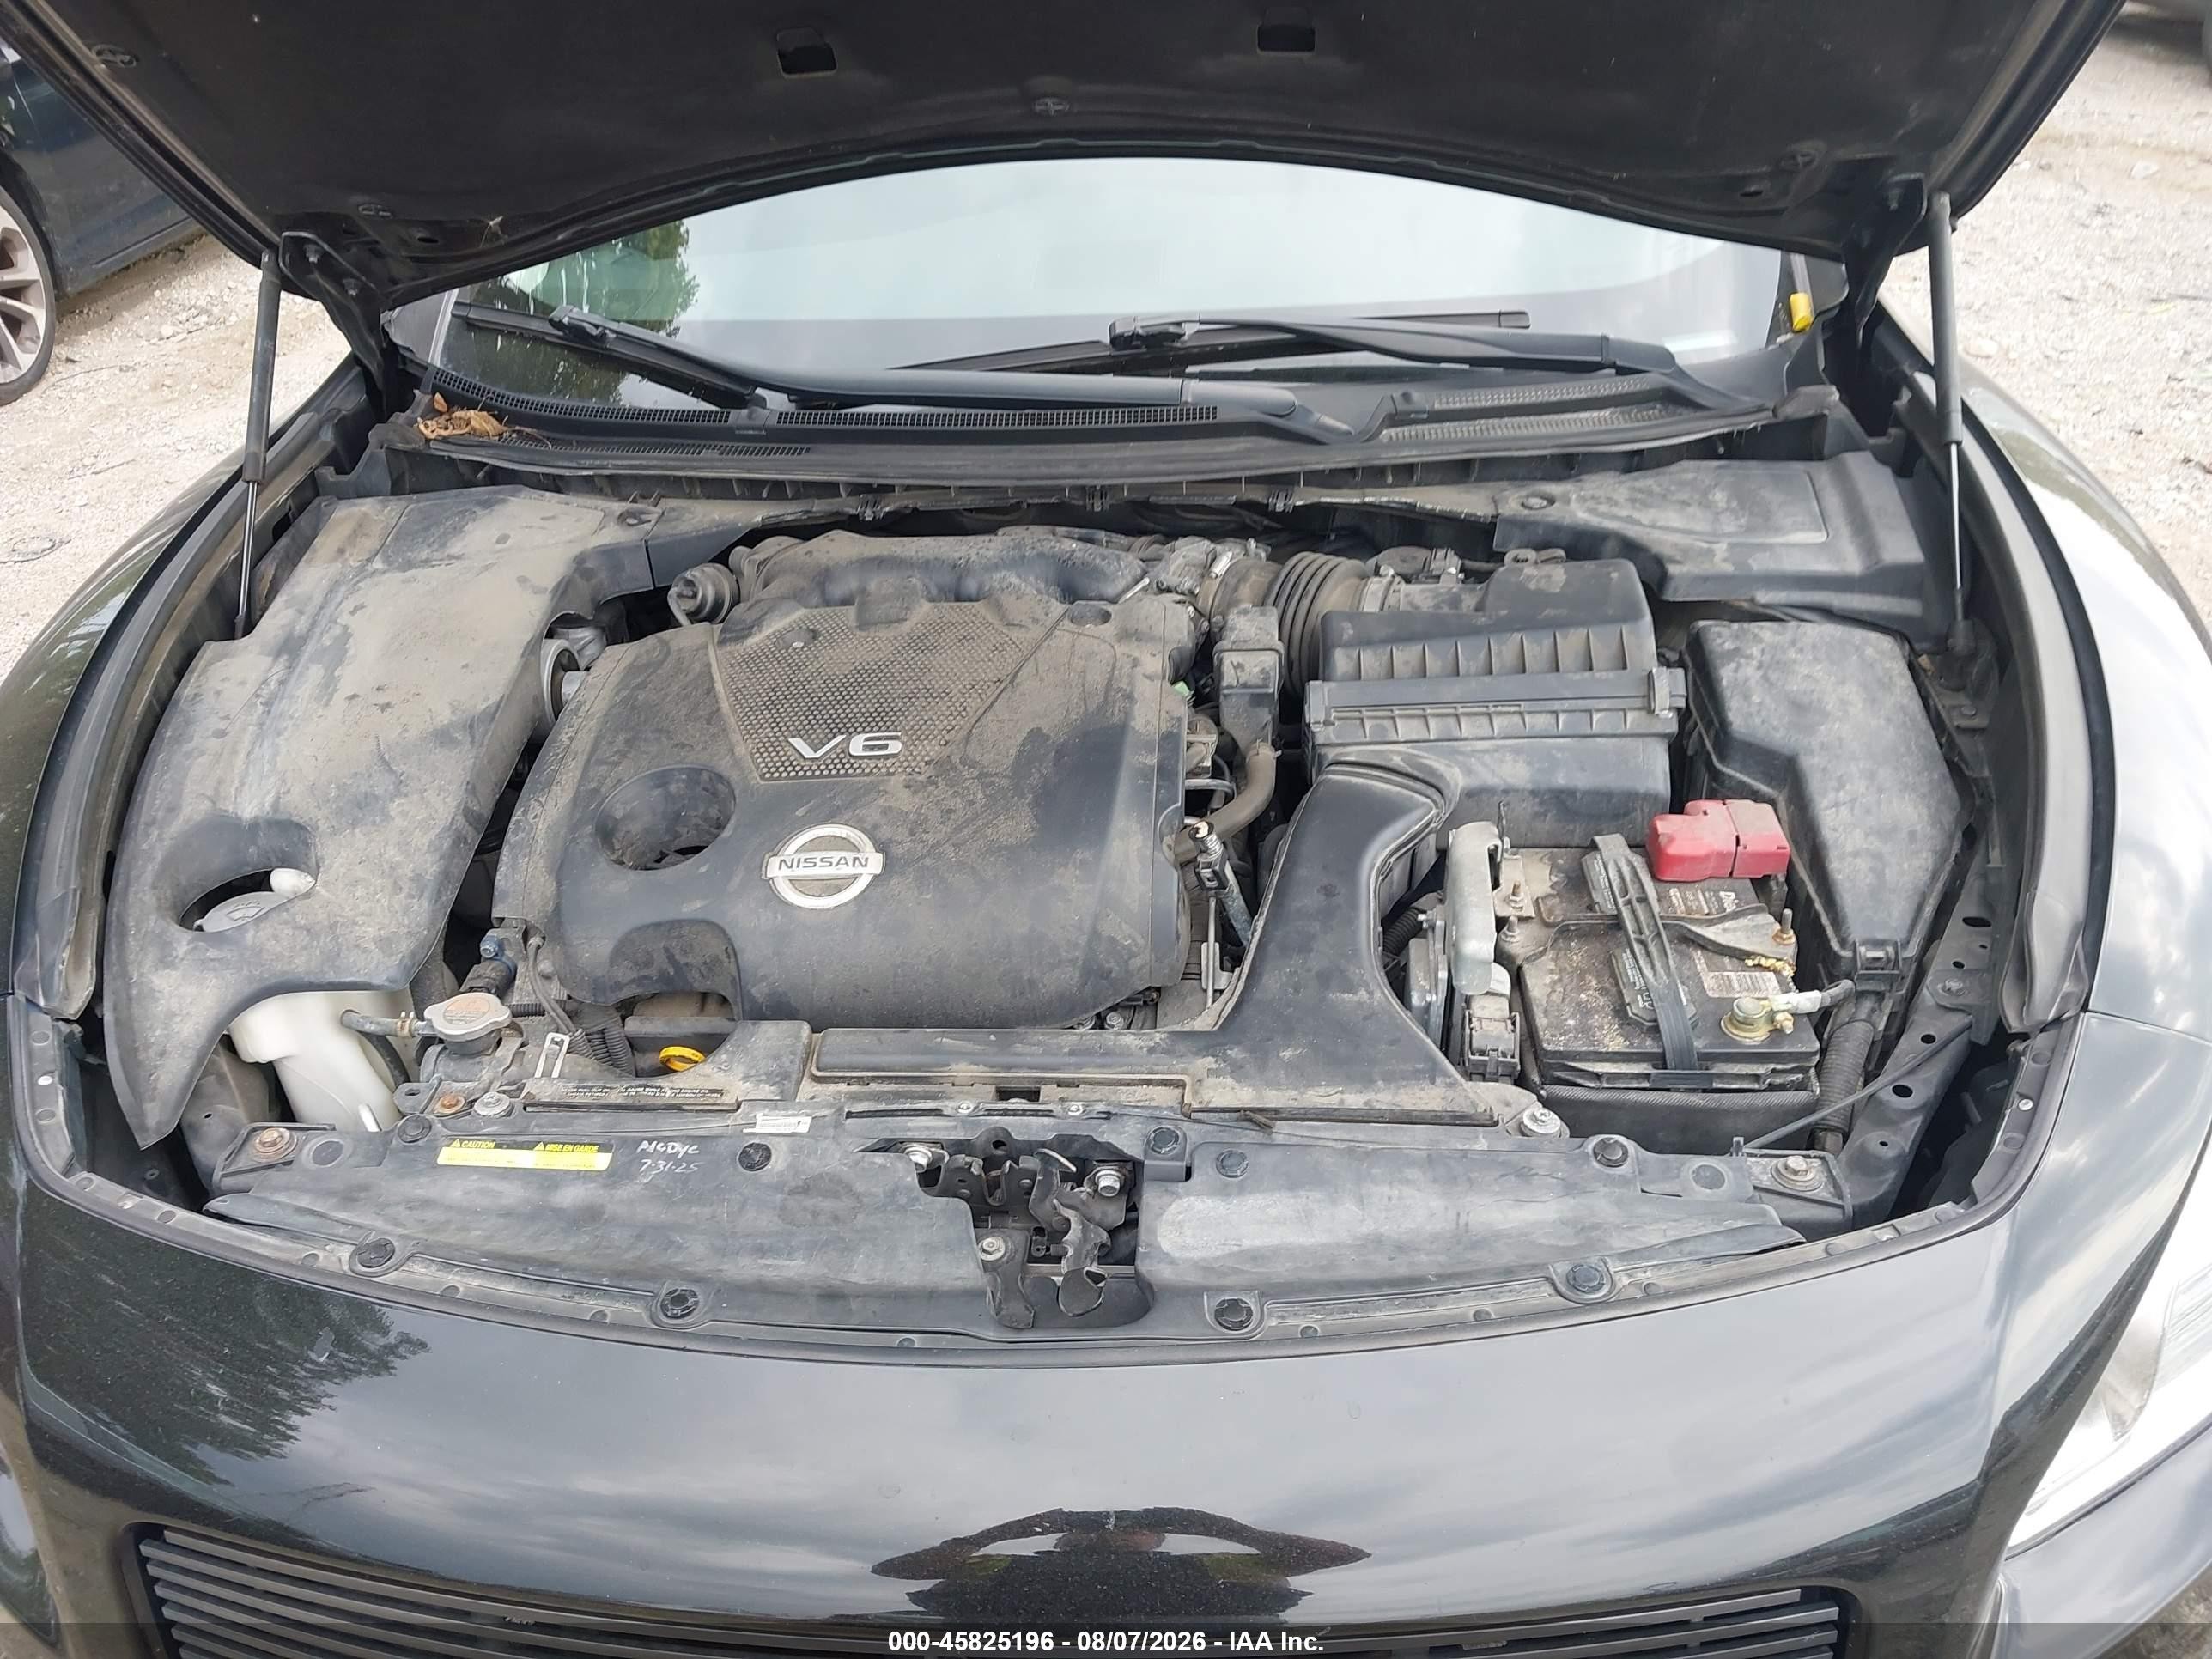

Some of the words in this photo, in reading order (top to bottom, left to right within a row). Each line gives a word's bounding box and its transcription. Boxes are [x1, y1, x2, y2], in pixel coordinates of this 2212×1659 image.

[788, 732, 902, 758] V6
[778, 855, 869, 871] NISSAN
[461, 1140, 495, 1149] CAUTION
[544, 1143, 563, 1152] MISE
[562, 1144, 574, 1152] EN
[574, 1144, 599, 1153] GARDE
